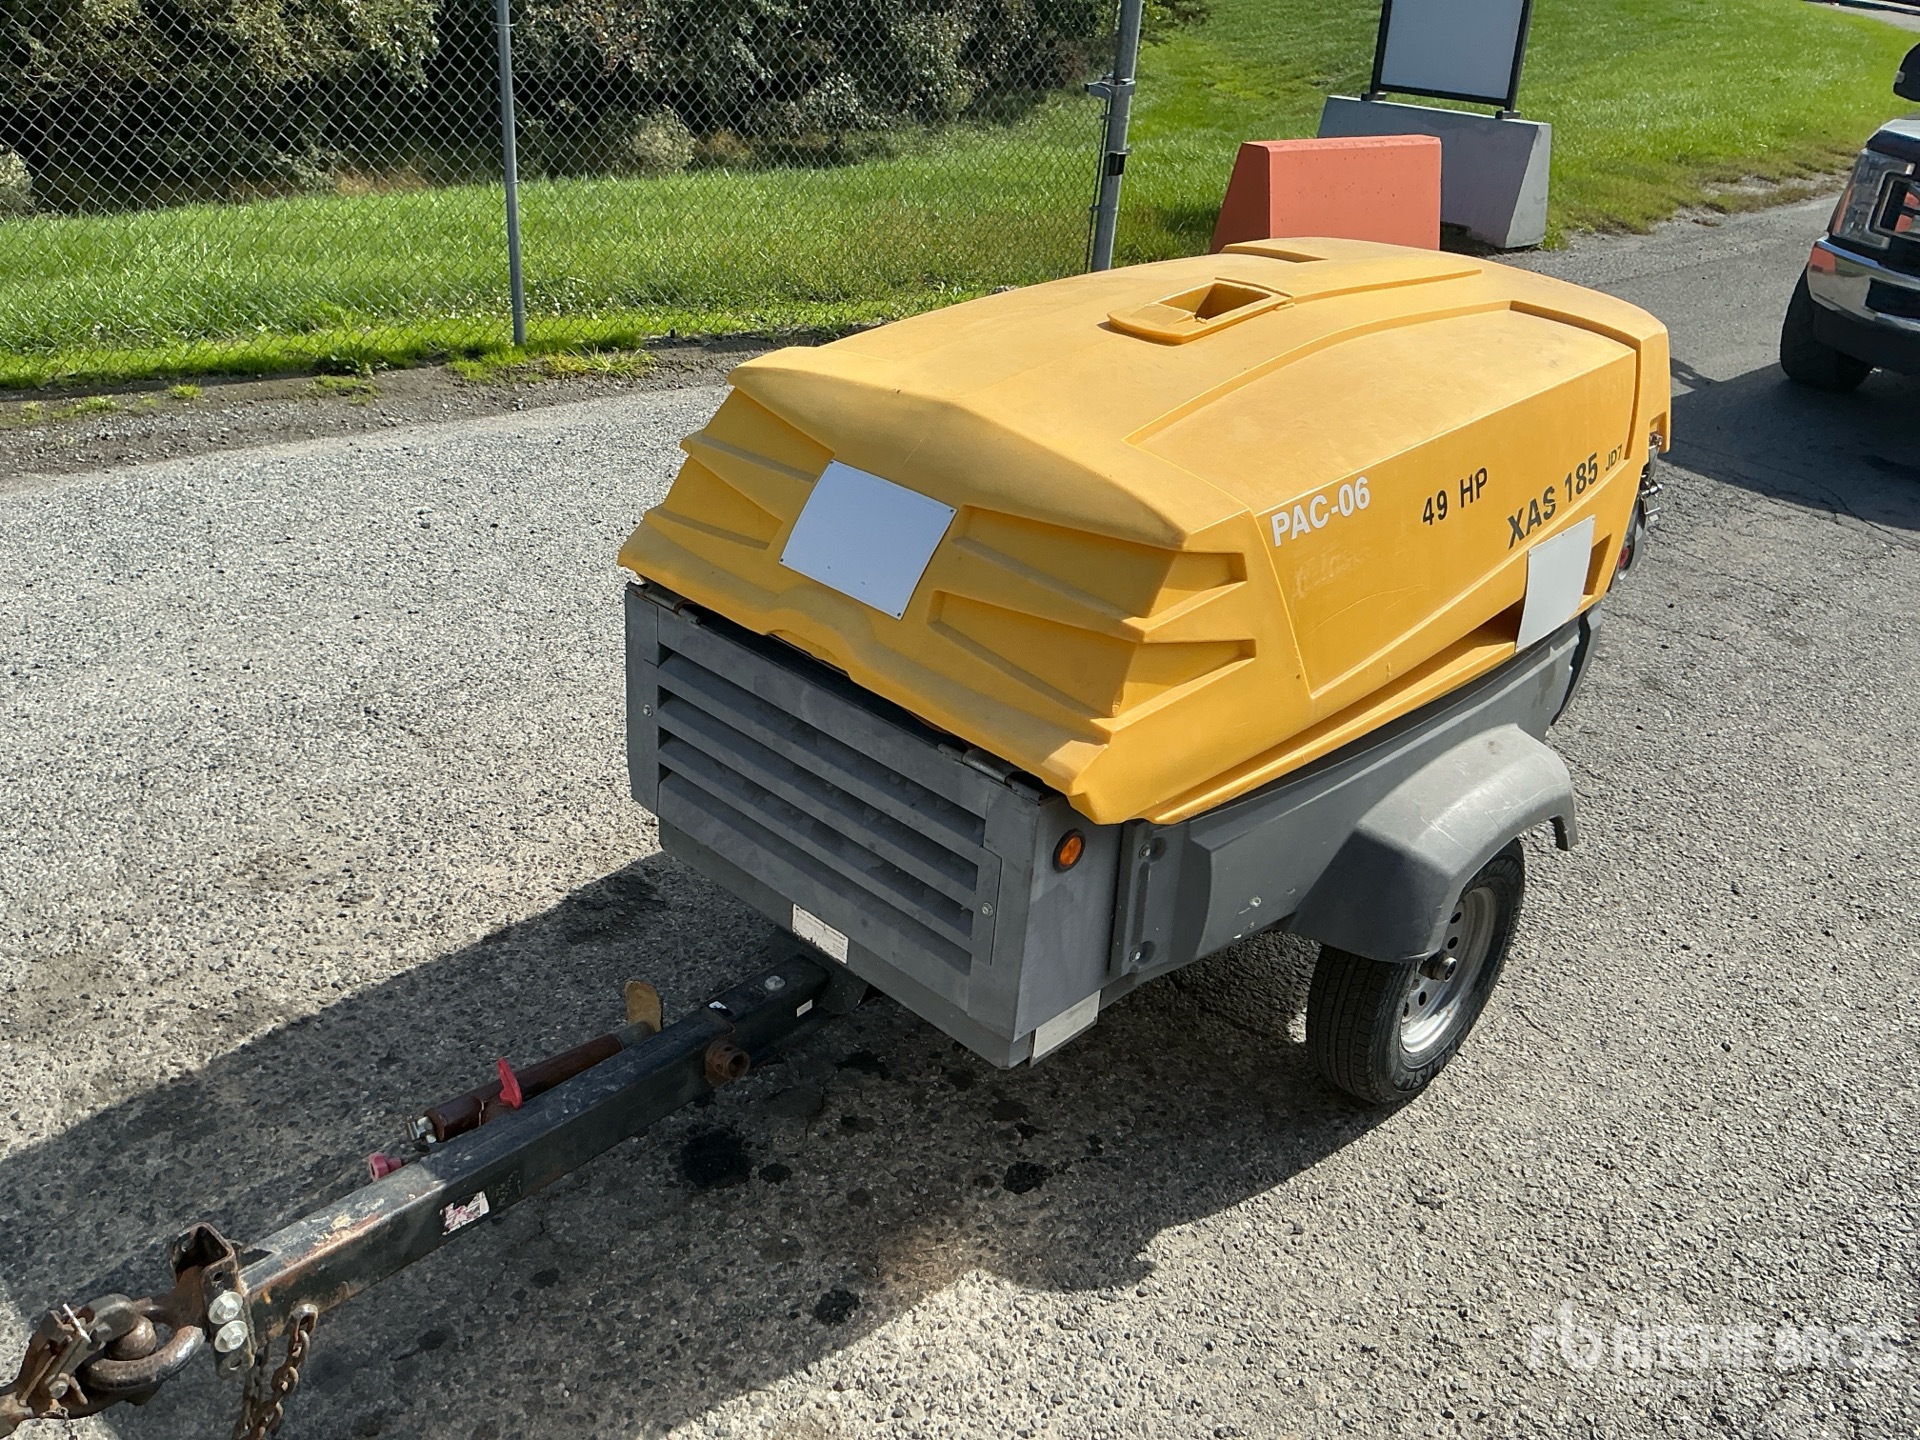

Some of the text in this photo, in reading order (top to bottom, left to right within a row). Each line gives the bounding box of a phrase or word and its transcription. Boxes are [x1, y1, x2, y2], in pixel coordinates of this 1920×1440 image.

[1271, 476, 1371, 547] PAC-06
[1422, 467, 1488, 526] 49 HP
[1507, 443, 1623, 550] XAS 185 JD7
